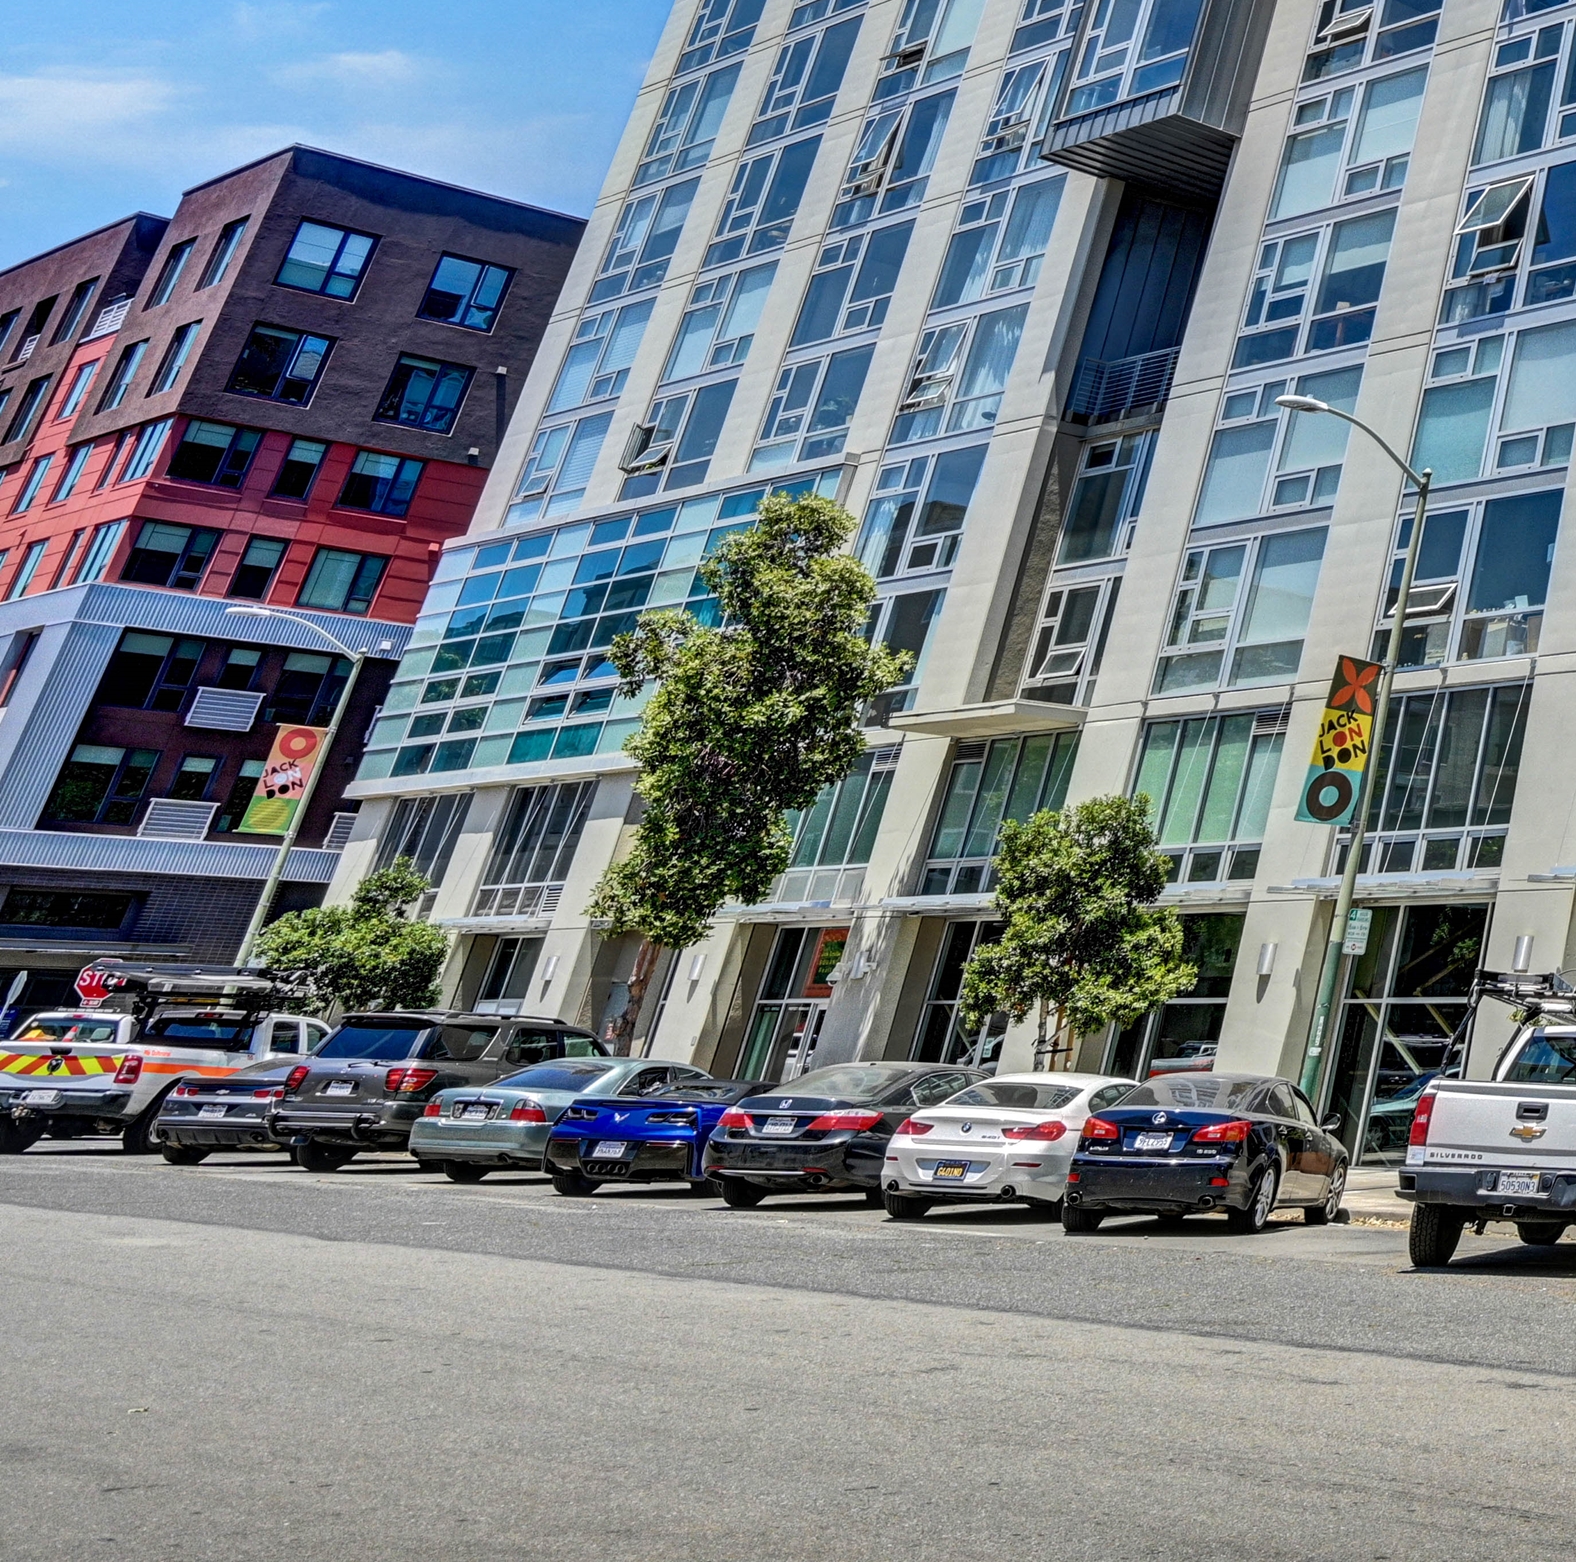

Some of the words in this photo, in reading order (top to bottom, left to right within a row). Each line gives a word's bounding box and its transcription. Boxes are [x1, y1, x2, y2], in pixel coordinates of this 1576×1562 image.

[1319, 709, 1358, 738] JACK
[1319, 723, 1363, 755] LON
[263, 758, 299, 778] JACK
[1322, 739, 1367, 771] DON
[1429, 1151, 1483, 1160] SILVERADO
